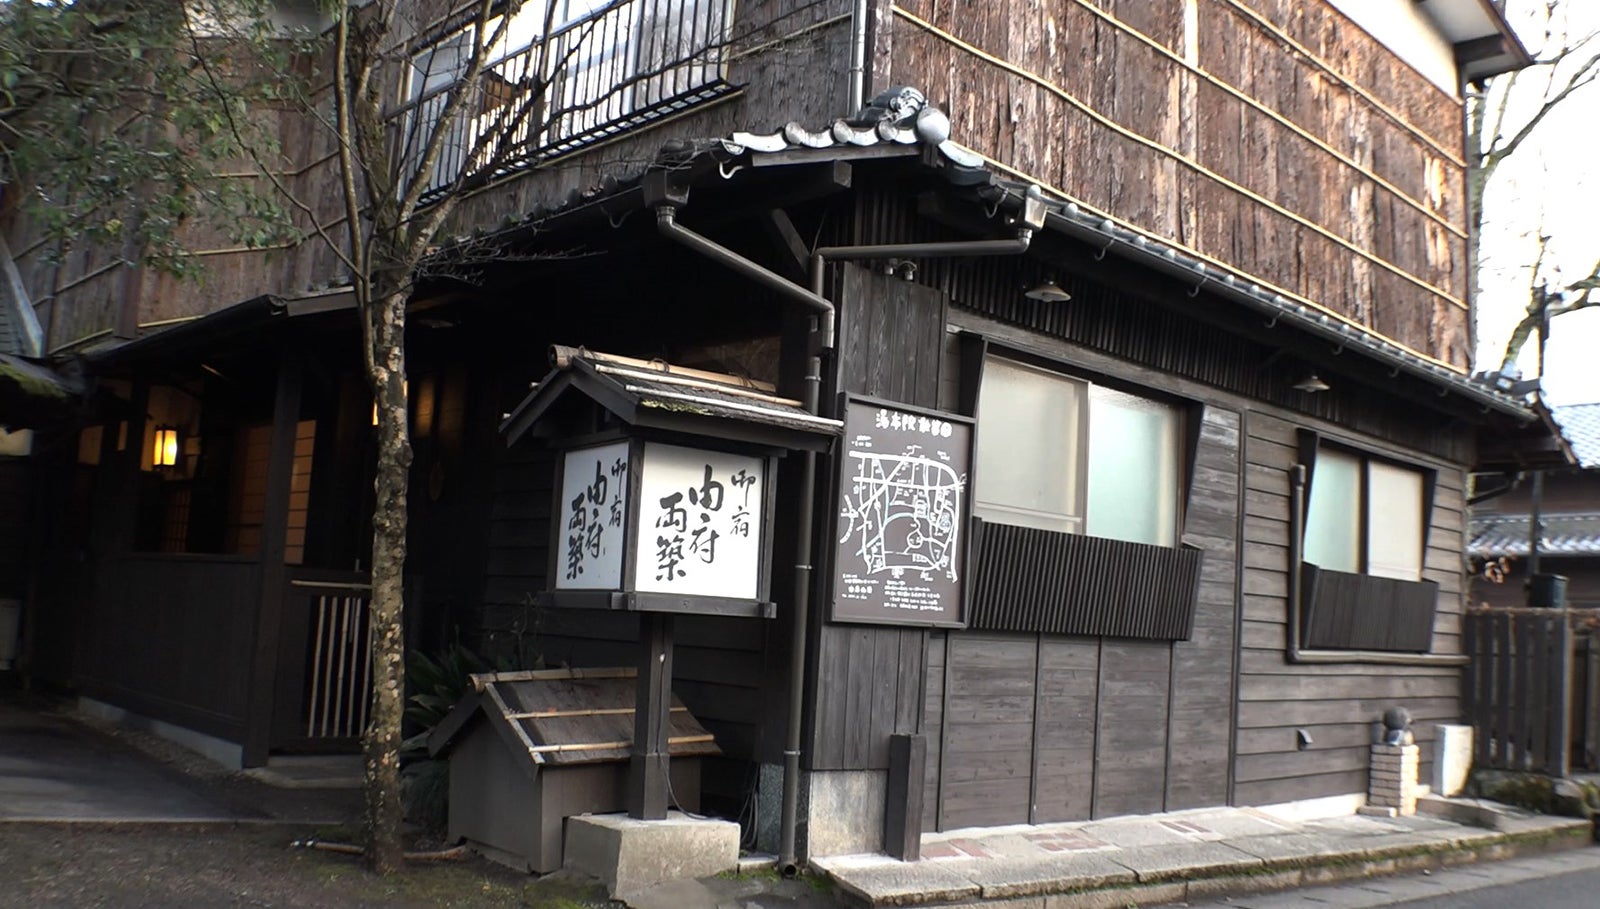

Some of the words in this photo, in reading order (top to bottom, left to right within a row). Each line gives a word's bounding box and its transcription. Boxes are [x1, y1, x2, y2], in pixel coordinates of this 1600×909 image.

[566, 492, 586, 580] 両築
[655, 491, 687, 582] 両築
[731, 468, 757, 538] 御宿
